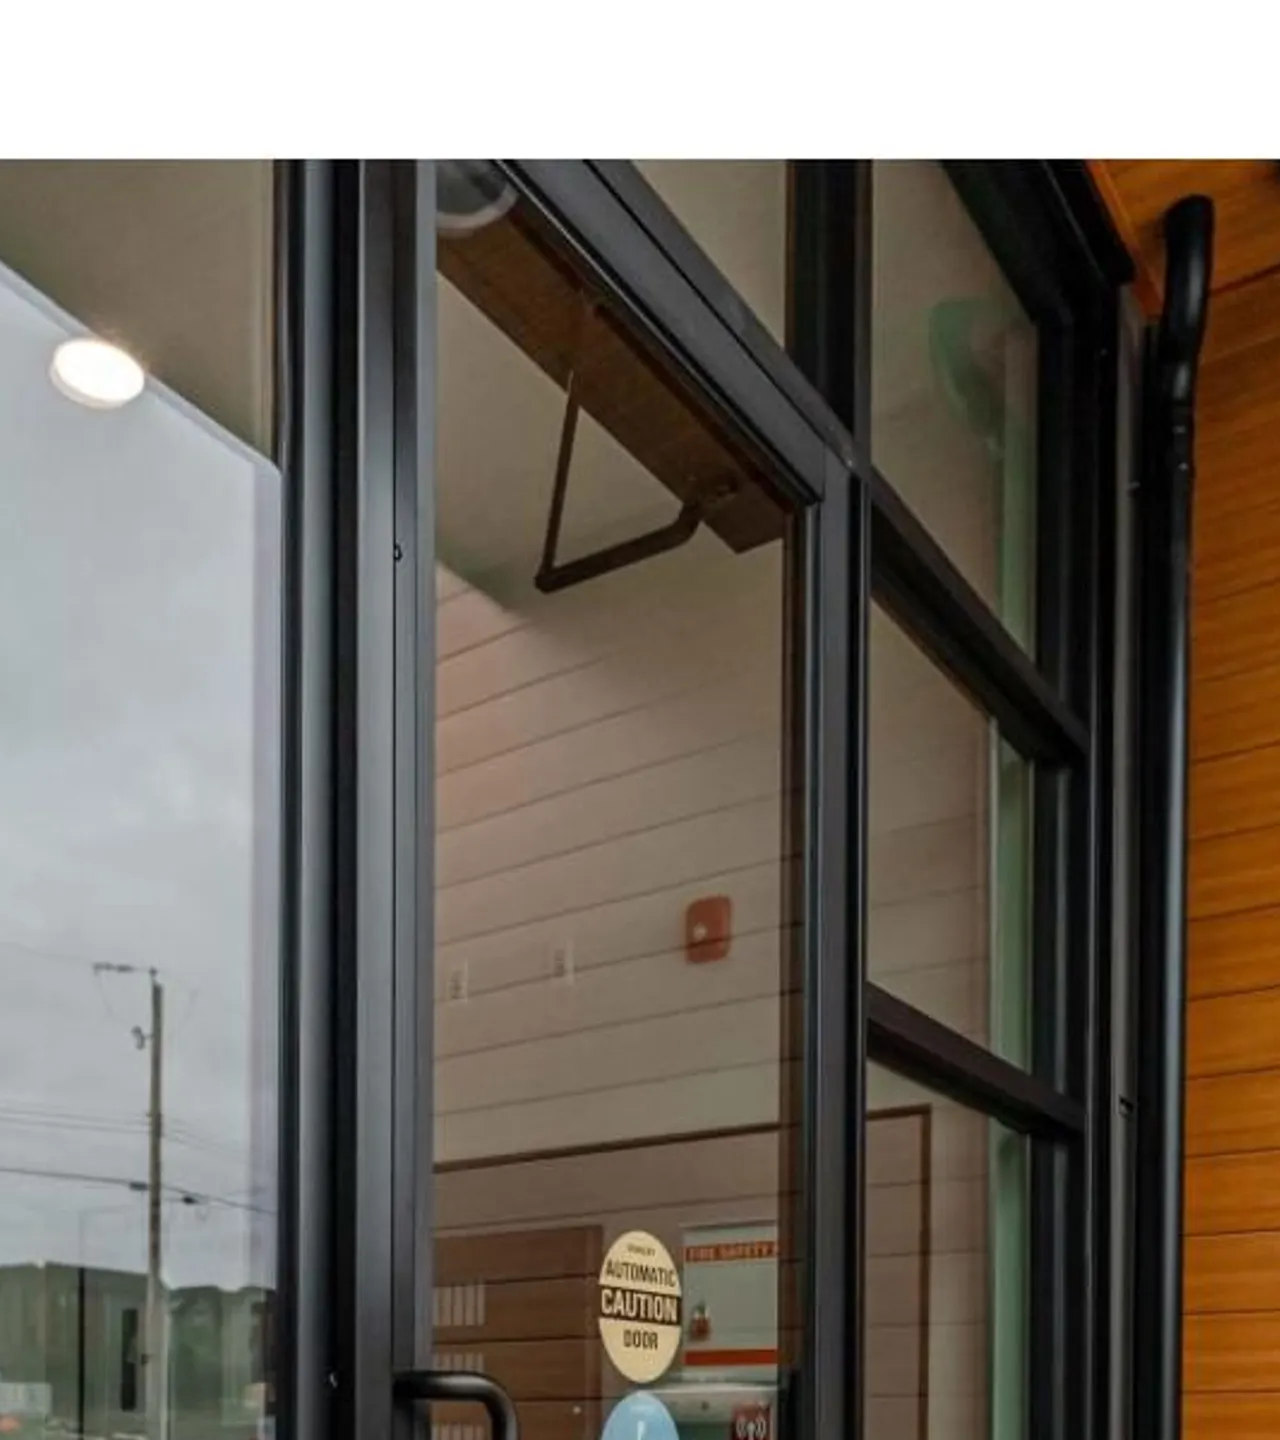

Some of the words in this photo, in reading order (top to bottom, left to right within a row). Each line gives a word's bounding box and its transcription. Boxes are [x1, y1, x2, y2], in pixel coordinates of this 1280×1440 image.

[605, 1259, 677, 1288] AUTOMATIC
[601, 1287, 678, 1323] CAUTION
[623, 1329, 659, 1351] DOOR
